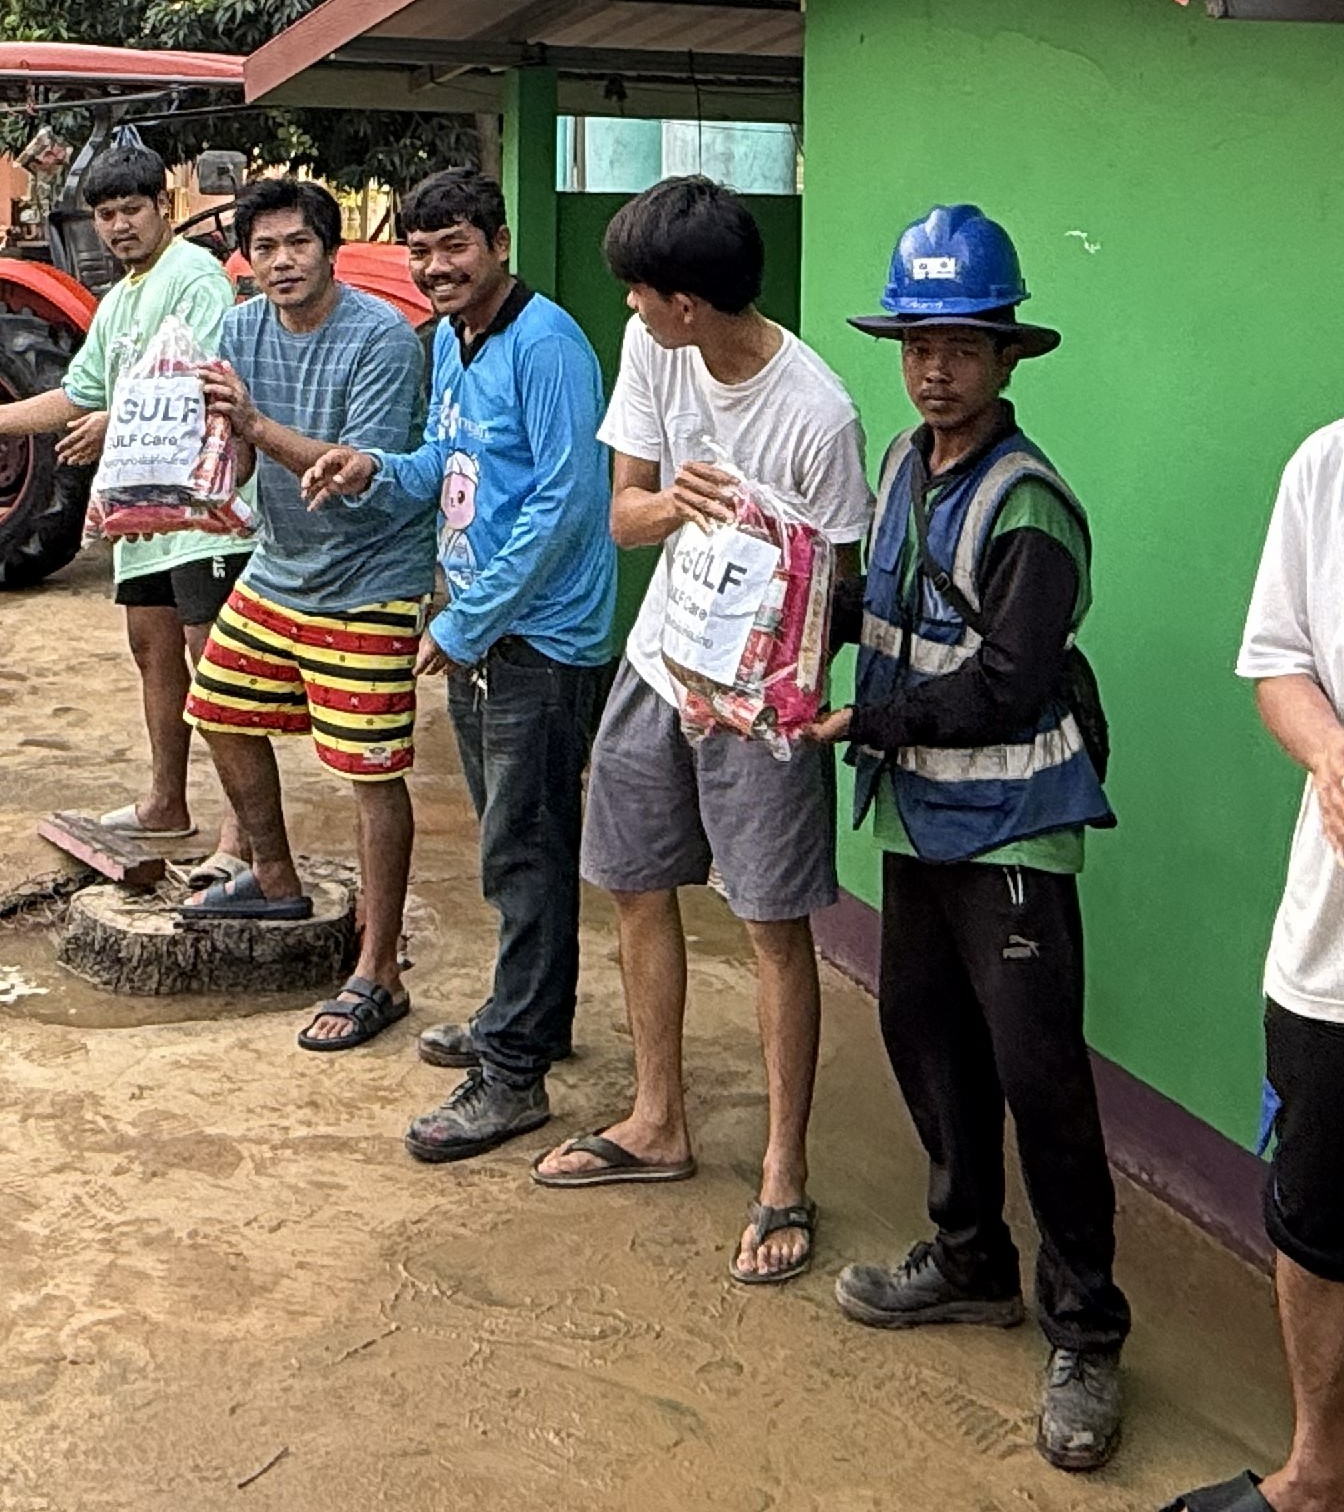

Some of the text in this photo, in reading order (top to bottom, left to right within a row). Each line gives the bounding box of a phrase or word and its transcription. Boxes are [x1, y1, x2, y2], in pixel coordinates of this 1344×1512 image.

[117, 396, 200, 425] GULF
[107, 432, 178, 451] ULF Care
